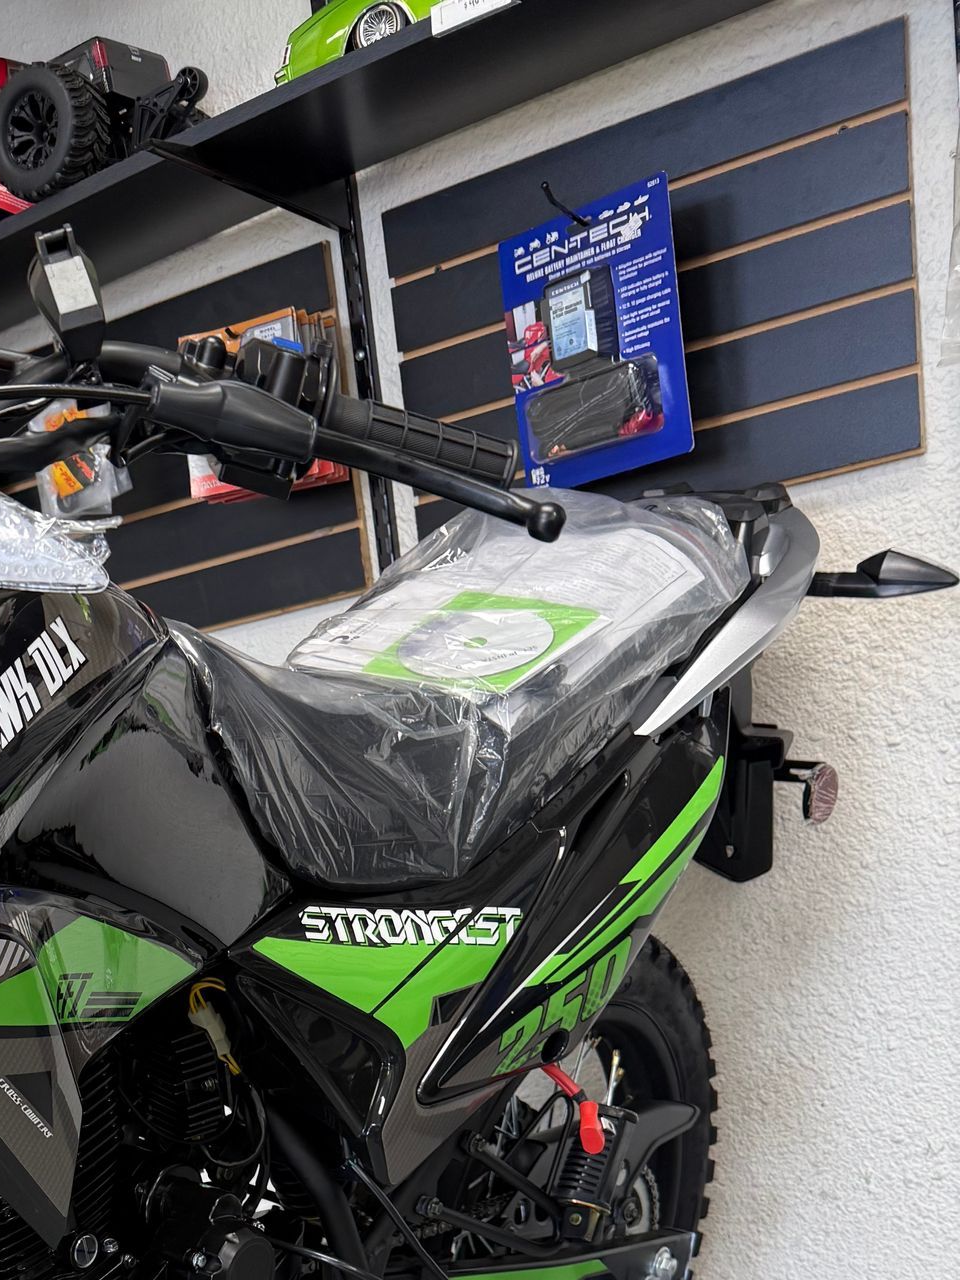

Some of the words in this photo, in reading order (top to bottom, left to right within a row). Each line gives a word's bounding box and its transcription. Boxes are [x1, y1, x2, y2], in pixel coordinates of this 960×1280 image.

[26, 615, 89, 697] DLX
[298, 905, 523, 947] STRONGEST
[491, 935, 632, 1077] 250
